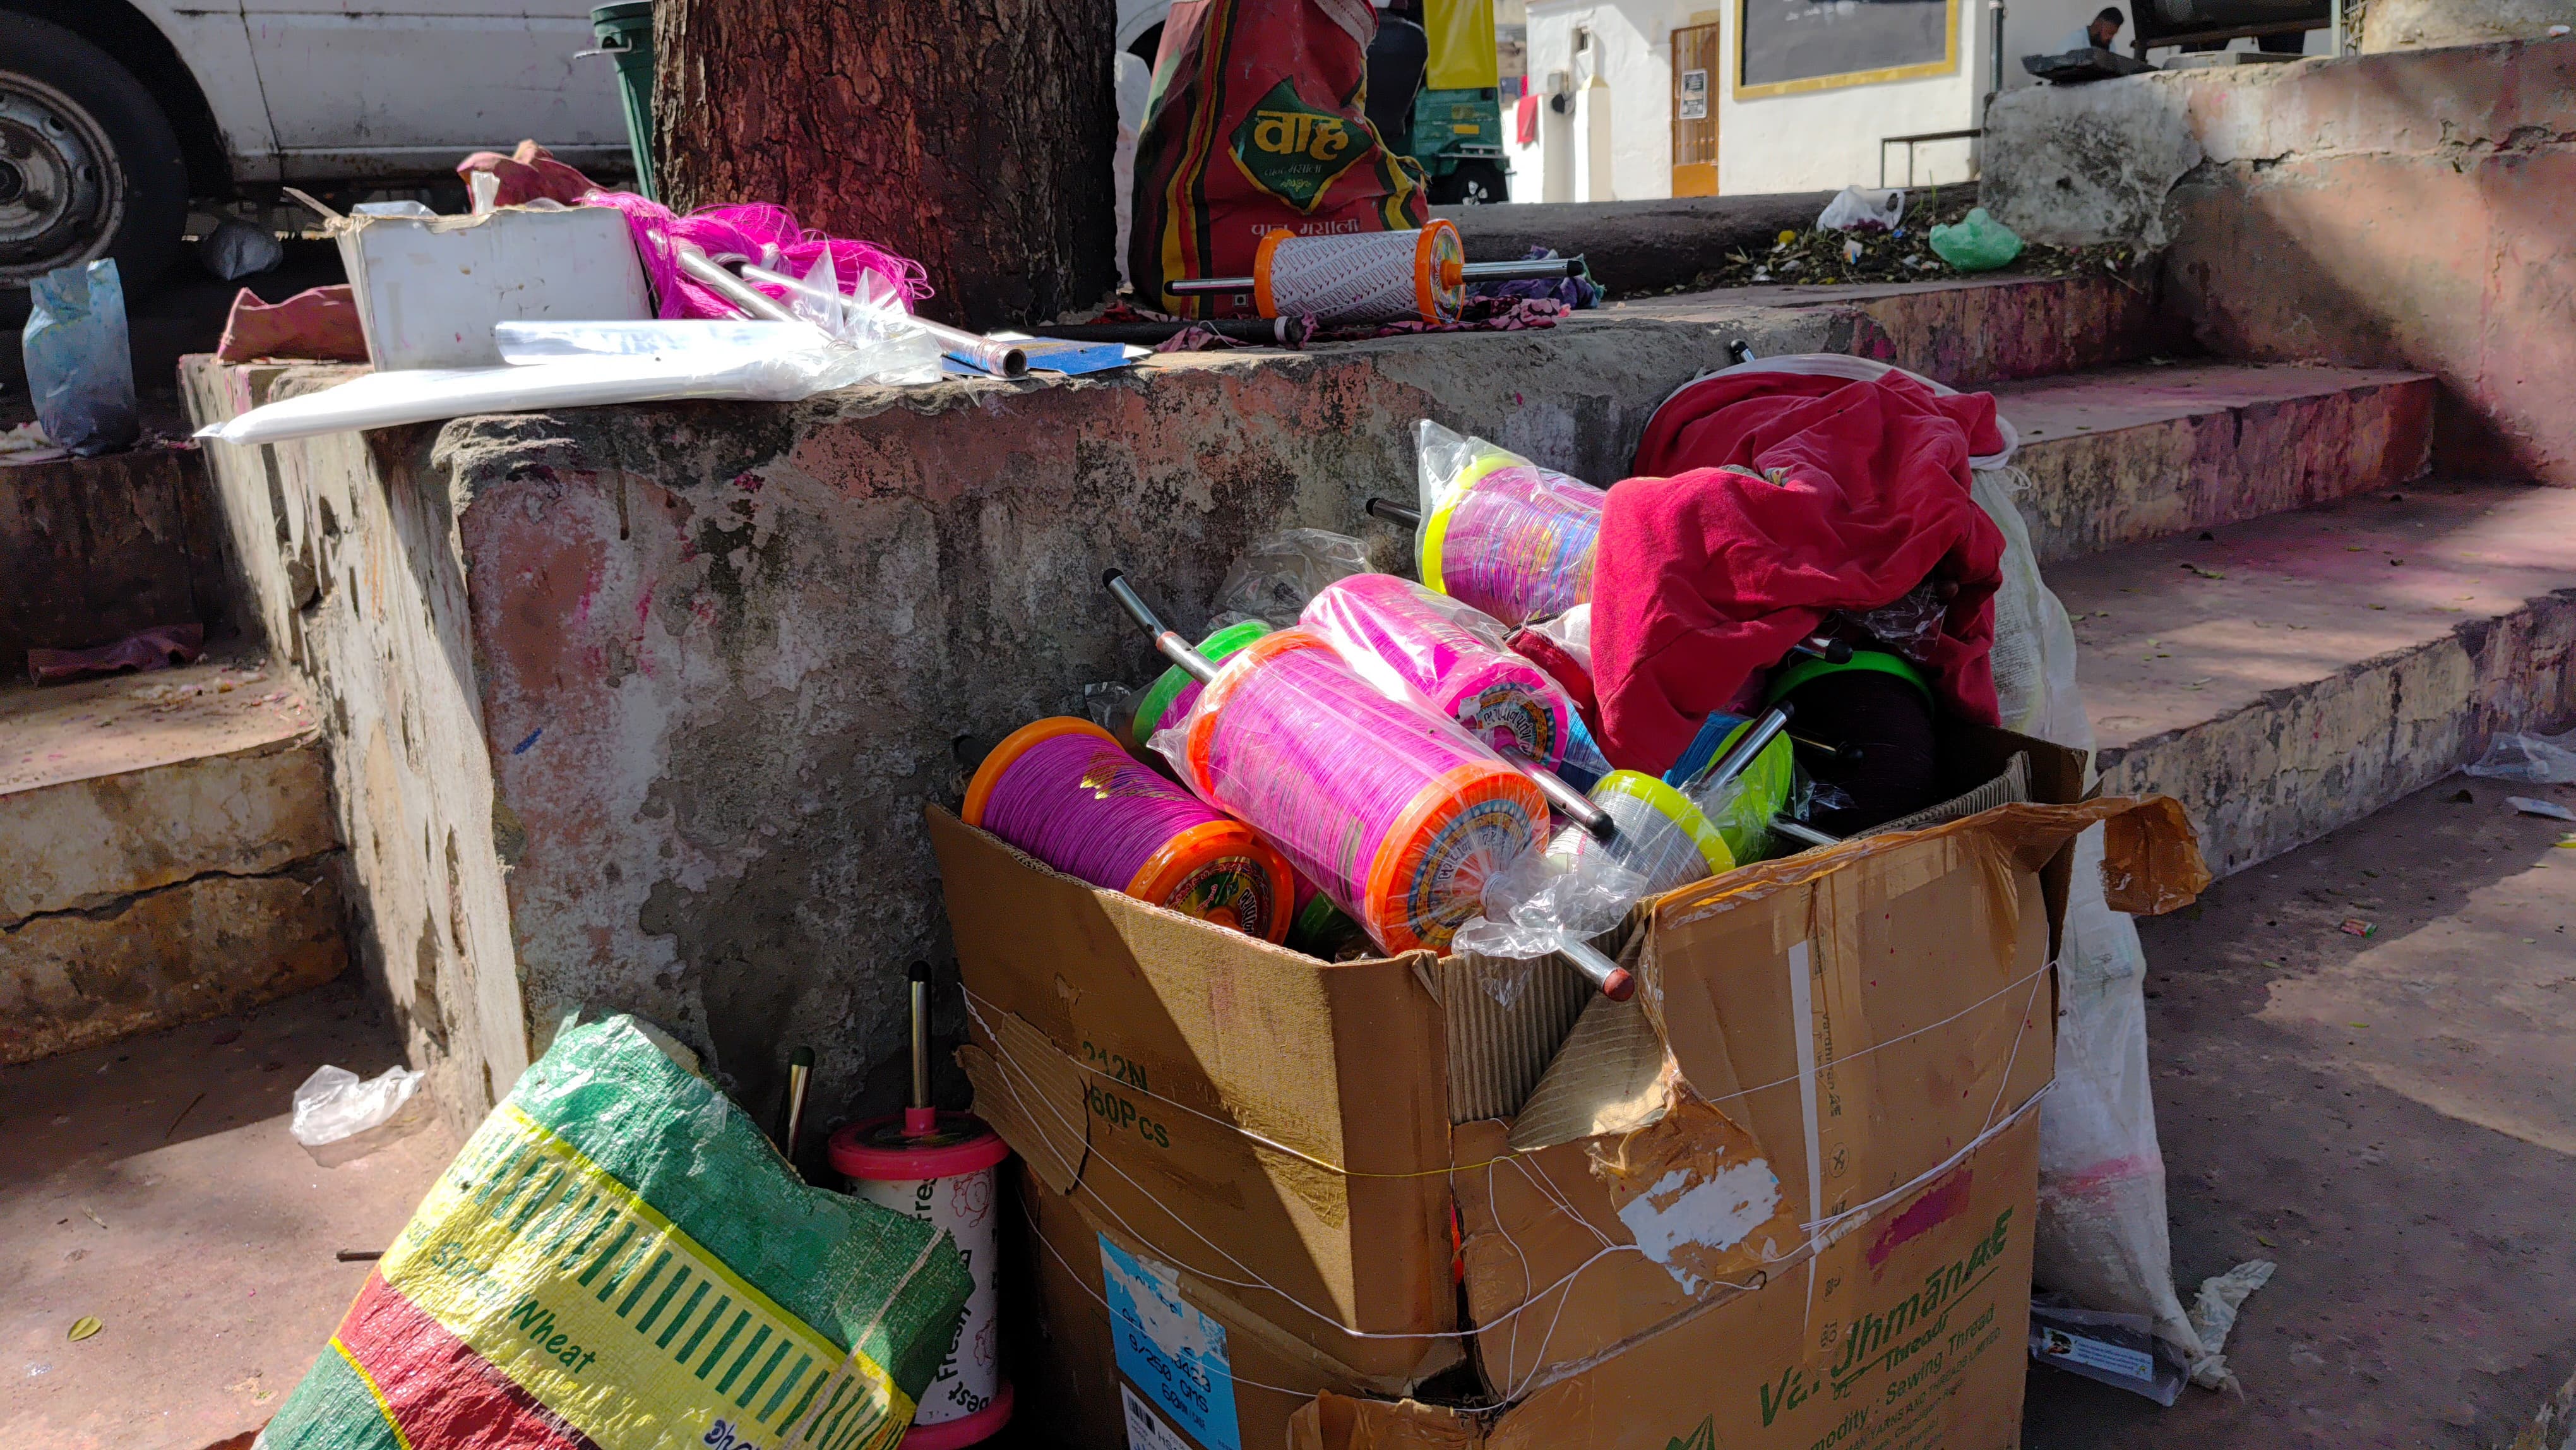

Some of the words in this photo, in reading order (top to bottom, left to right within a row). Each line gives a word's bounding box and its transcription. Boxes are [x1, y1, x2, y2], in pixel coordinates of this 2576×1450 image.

[1254, 109, 1349, 160] वाह
[1299, 219, 1359, 236] मसाला
[508, 1293, 597, 1374] Wheat
